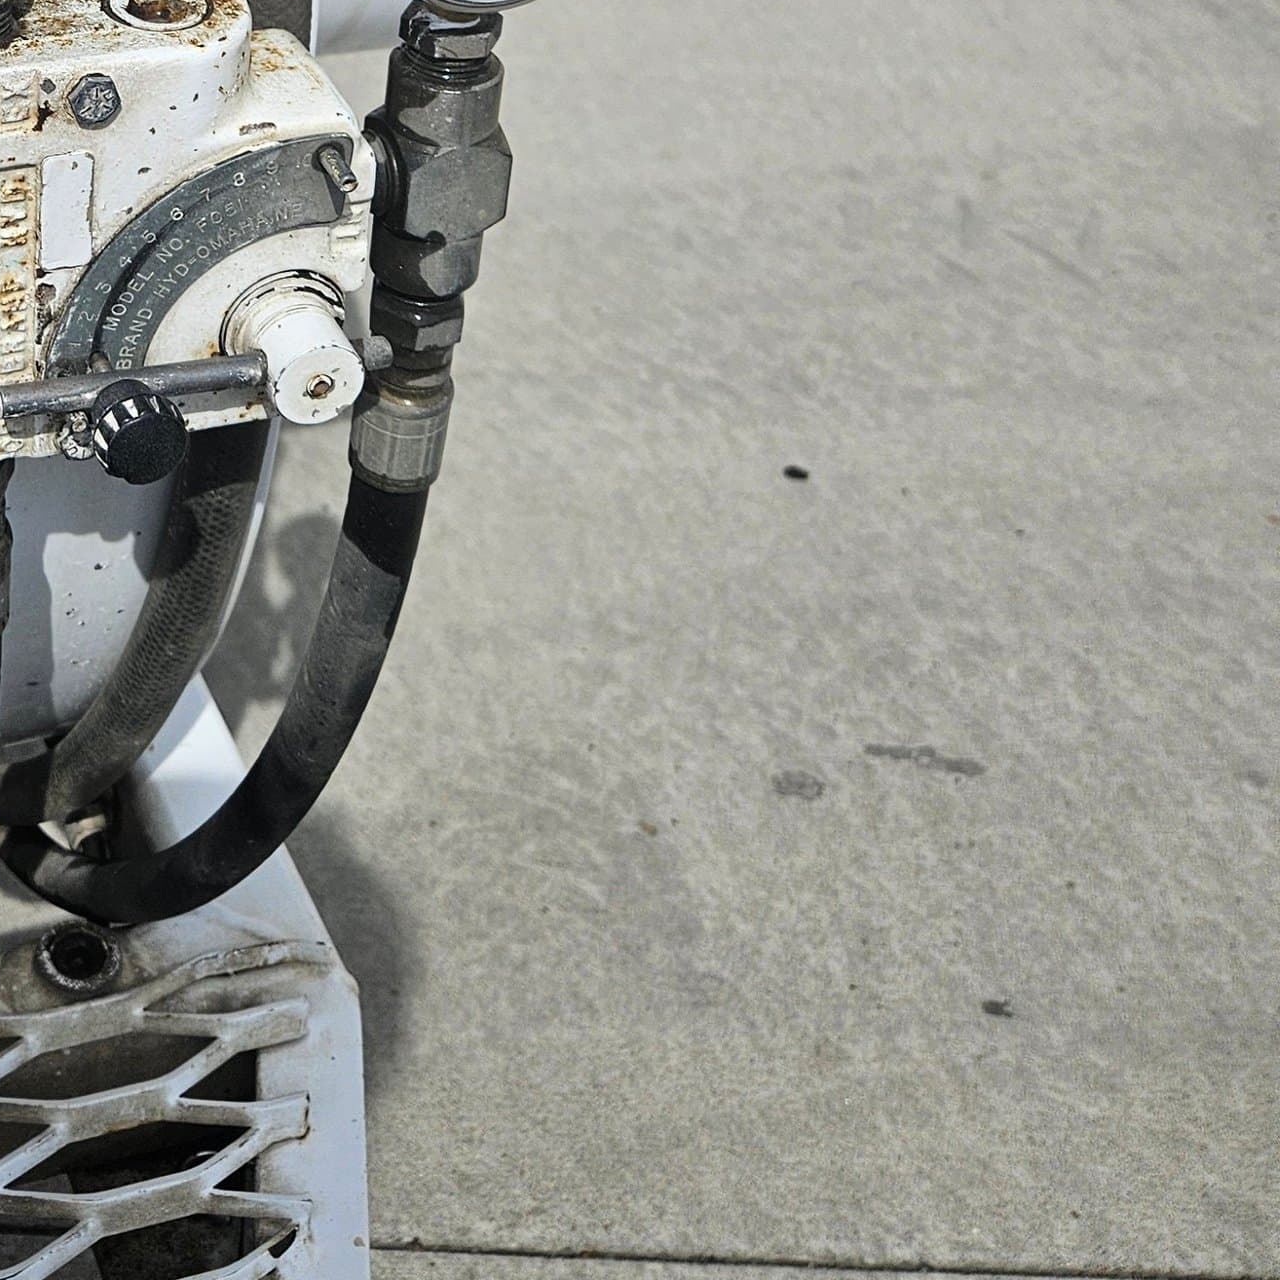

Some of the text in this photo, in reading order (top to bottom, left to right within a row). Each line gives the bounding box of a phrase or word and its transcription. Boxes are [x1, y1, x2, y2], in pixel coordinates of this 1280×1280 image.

[95, 282, 112, 294] 3
[170, 207, 184, 221] 6
[200, 187, 213, 202] 7
[233, 172, 246, 186] 8
[102, 270, 154, 331] MODEL
[156, 236, 190, 264] NO.
[115, 308, 153, 370] BRAND
